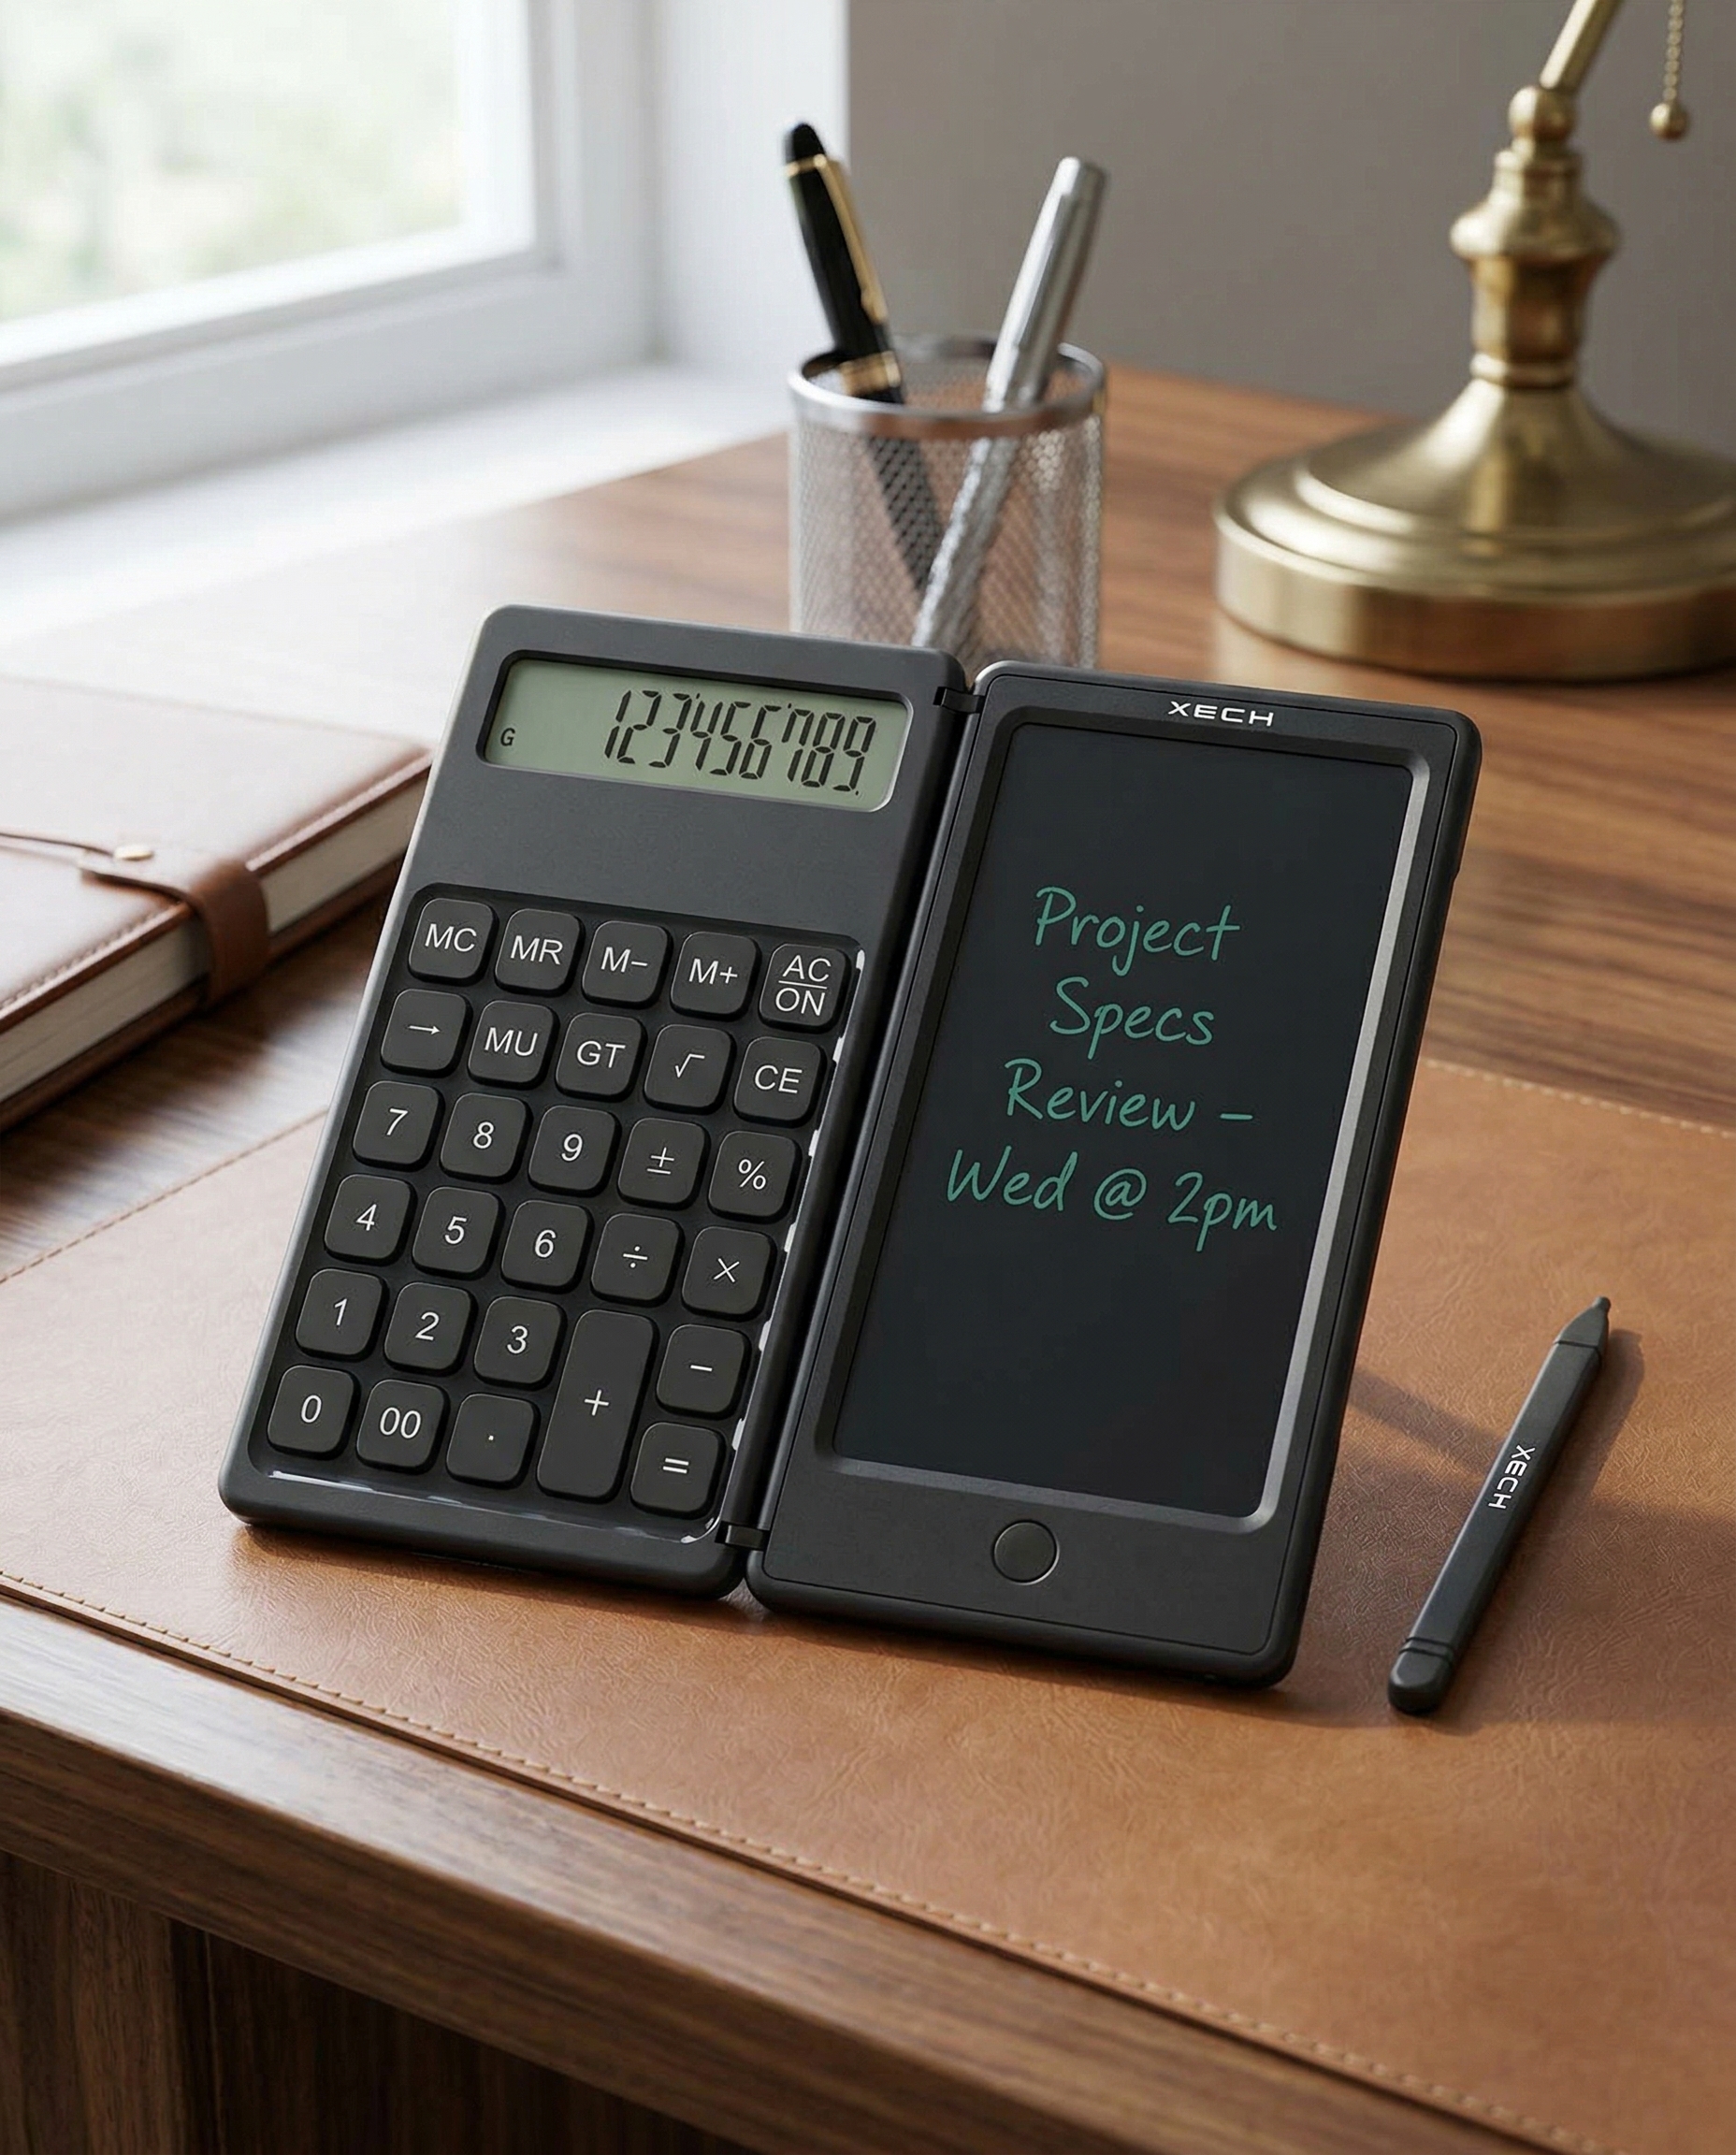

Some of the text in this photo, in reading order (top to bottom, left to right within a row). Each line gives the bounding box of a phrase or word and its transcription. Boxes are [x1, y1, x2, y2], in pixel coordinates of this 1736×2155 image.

[1167, 701, 1274, 727] XECH
[424, 923, 477, 952] MC
[1035, 886, 1240, 976] Project
[510, 934, 563, 965] MR
[688, 958, 738, 985] M+
[782, 955, 832, 982] AC
[774, 987, 826, 1017] ON
[1049, 976, 1215, 1060] Specs
[485, 1027, 538, 1056] MU
[576, 1040, 626, 1068] GT
[755, 1064, 803, 1094] CE
[1005, 1058, 1196, 1131] Review
[386, 1107, 409, 1135] 7
[473, 1121, 495, 1150] 8
[561, 1134, 583, 1162] 9
[947, 1145, 1277, 1251] Wed @ 2pm
[356, 1204, 377, 1231] 4
[444, 1216, 467, 1245] 5
[534, 1229, 557, 1258] 6
[334, 1298, 348, 1326] 1
[415, 1311, 440, 1341] 2
[507, 1325, 528, 1354] 3
[301, 1395, 322, 1424] 0
[380, 1407, 421, 1439] 00
[1488, 1445, 1536, 1510] XECH
